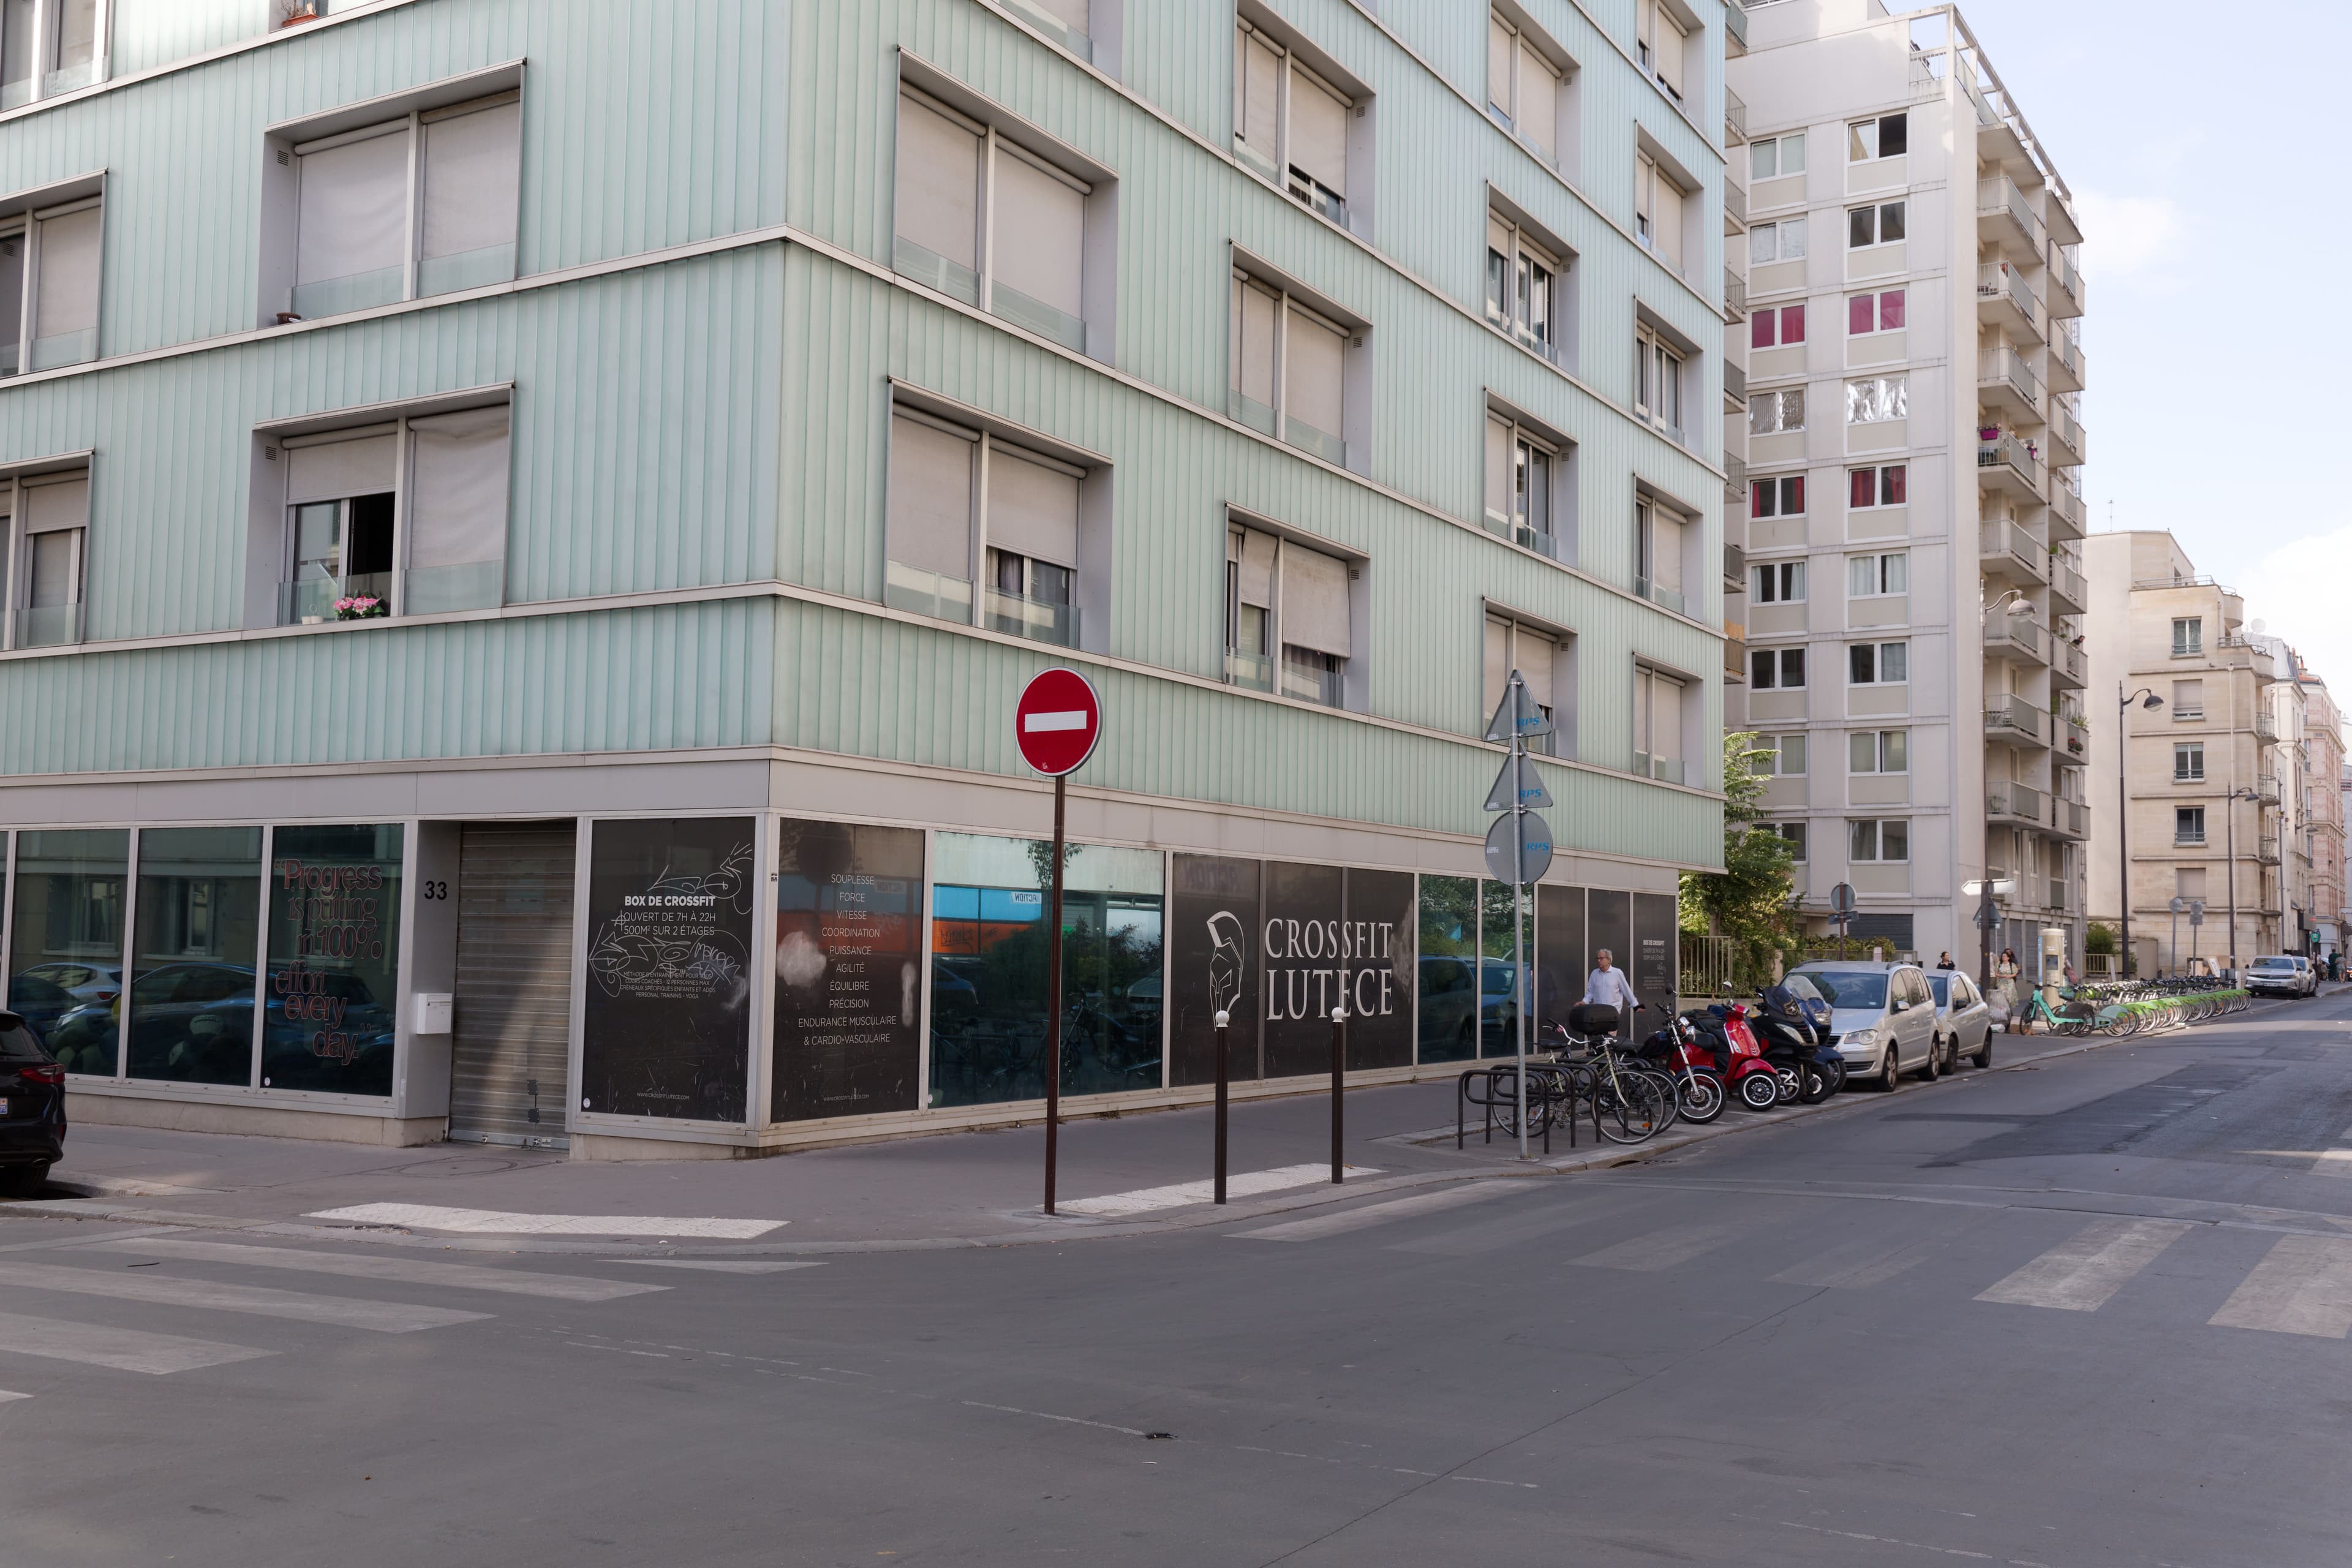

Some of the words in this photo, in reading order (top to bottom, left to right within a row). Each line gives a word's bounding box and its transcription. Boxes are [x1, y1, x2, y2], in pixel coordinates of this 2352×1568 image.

[1519, 788, 1542, 798] RPS
[1527, 842, 1549, 851] RPS
[831, 873, 875, 885] SOUPLESSE
[424, 880, 447, 900] 33
[625, 895, 646, 907] BOX
[648, 895, 662, 907] DE
[665, 895, 715, 907] CROSSFIT
[839, 892, 865, 902] FORCE
[287, 888, 304, 921] is
[306, 888, 377, 931] putting
[837, 910, 867, 919] VITESSE
[624, 912, 659, 921] OUVERT
[662, 912, 674, 921] DE
[677, 912, 688, 921] 7H
[690, 910, 697, 921] À
[699, 912, 716, 921] 22H
[652, 925, 670, 935] SUR
[673, 925, 678, 935] 2
[680, 924, 715, 935] ÉTAGES
[822, 927, 880, 937] COORDINATION
[296, 922, 315, 956] in
[317, 925, 382, 960] 100%
[1265, 918, 1393, 959] CROSSFIT
[830, 945, 872, 955] PUISSANCE
[836, 962, 865, 973] AGILITÉ
[276, 960, 328, 995] effort
[830, 980, 869, 990] ÉQUILIBRE
[1266, 968, 1392, 1020] LUTECE
[829, 997, 869, 1008] PRÉCISION
[285, 995, 348, 1029] every
[799, 1017, 847, 1027] ENDURANCE
[850, 1016, 897, 1026] MUSCULAIRE
[804, 1036, 810, 1046] &
[812, 1033, 890, 1045] CARDIO-VASCULAIRE
